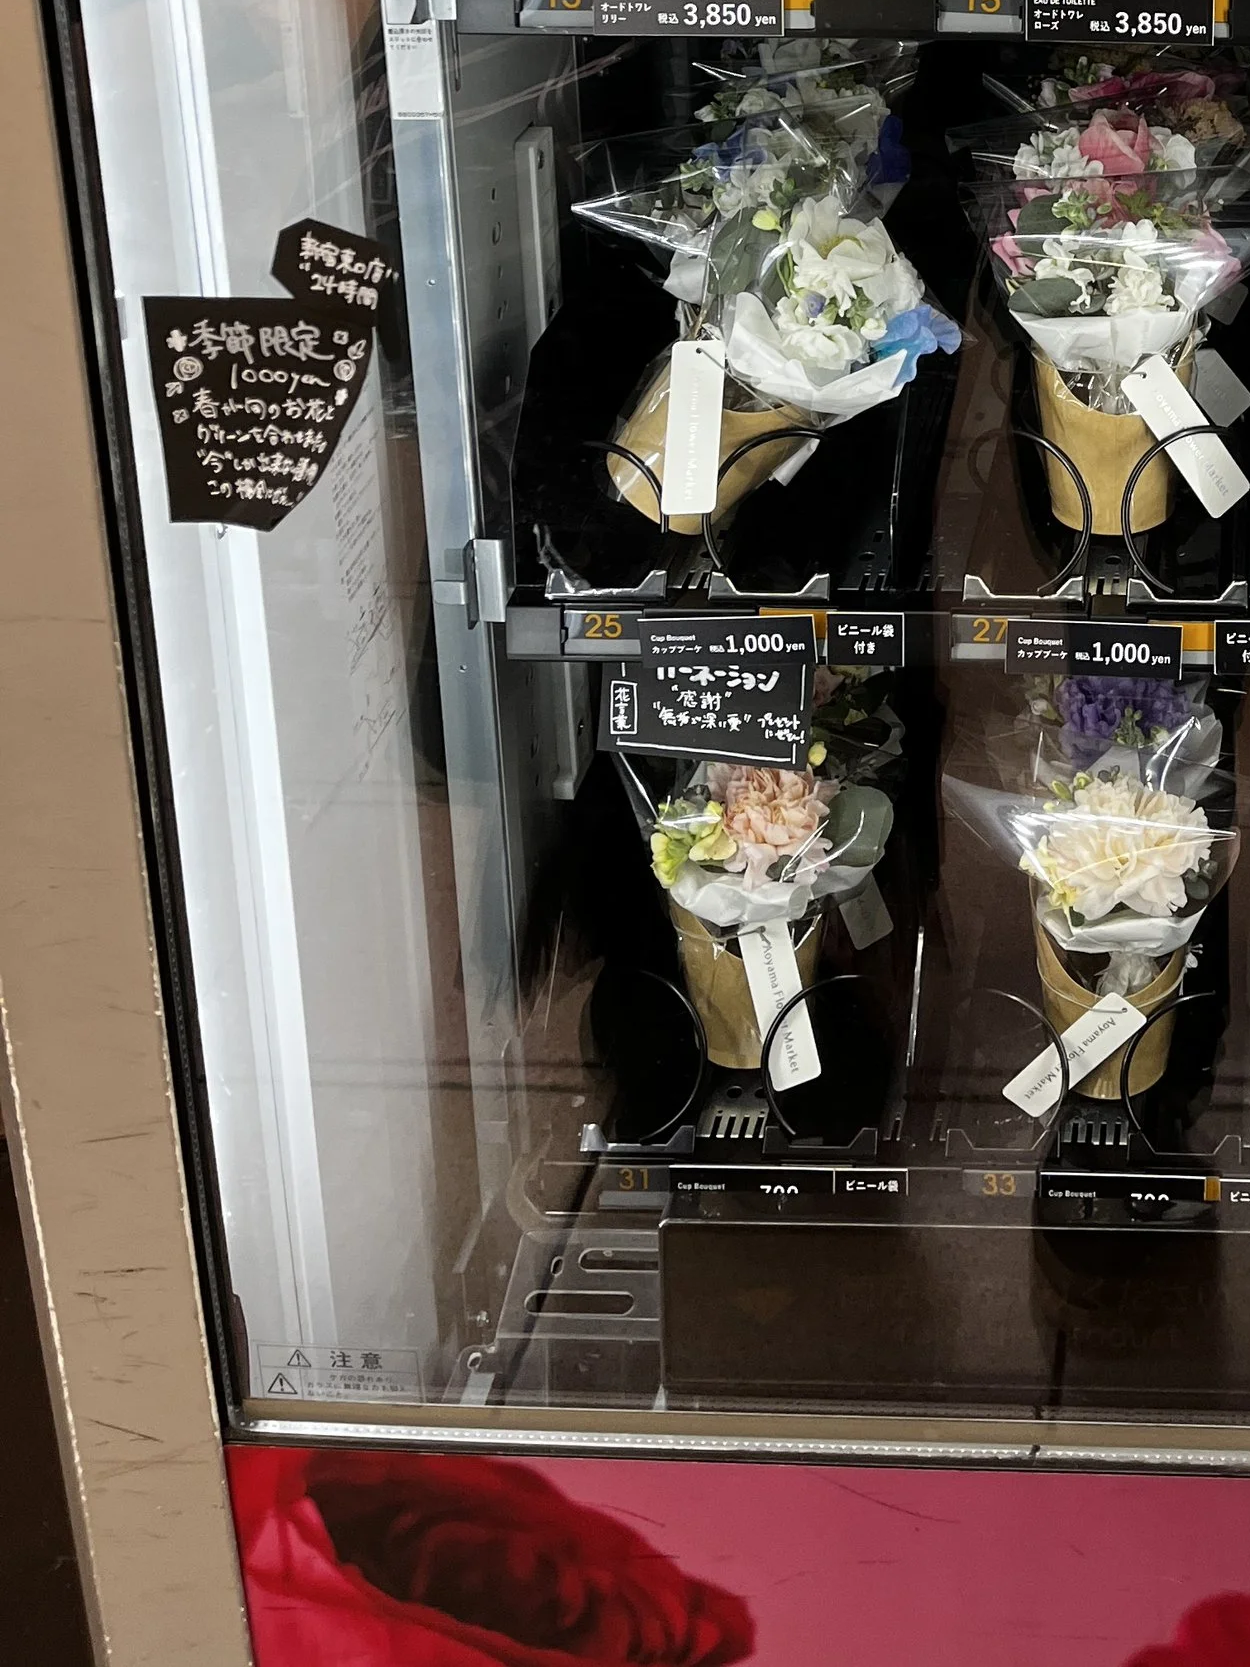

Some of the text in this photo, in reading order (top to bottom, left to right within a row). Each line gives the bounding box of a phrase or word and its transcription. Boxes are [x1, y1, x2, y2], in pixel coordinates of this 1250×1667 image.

[600, 2, 652, 13] オードトワレ
[602, 3, 776, 29] リリー 税込 3,850 yen
[1033, 9, 1084, 20] オードトワレ
[1034, 11, 1206, 37] ローズ 税込 3,850 yen
[188, 318, 336, 365] 季節限定
[585, 614, 622, 638] 25
[837, 624, 895, 638] ビニール袋
[972, 618, 1007, 642] 27
[650, 634, 696, 643] Cup Bouquet
[652, 645, 702, 655] カップブーケ
[725, 634, 784, 656] 1,000
[786, 641, 805, 653] yen
[854, 642, 876, 655] 付き
[1017, 636, 1063, 646] Cup Bouquet
[1017, 649, 1067, 660] カップブーケ
[1092, 641, 1150, 664] 1,000
[1152, 653, 1171, 665] yen
[614, 686, 632, 730] 花言葉
[1023, 1017, 1117, 1100] Aoyama Market
[618, 1168, 650, 1190] 31
[982, 1173, 1016, 1195] 33
[330, 1350, 383, 1370] 注意
